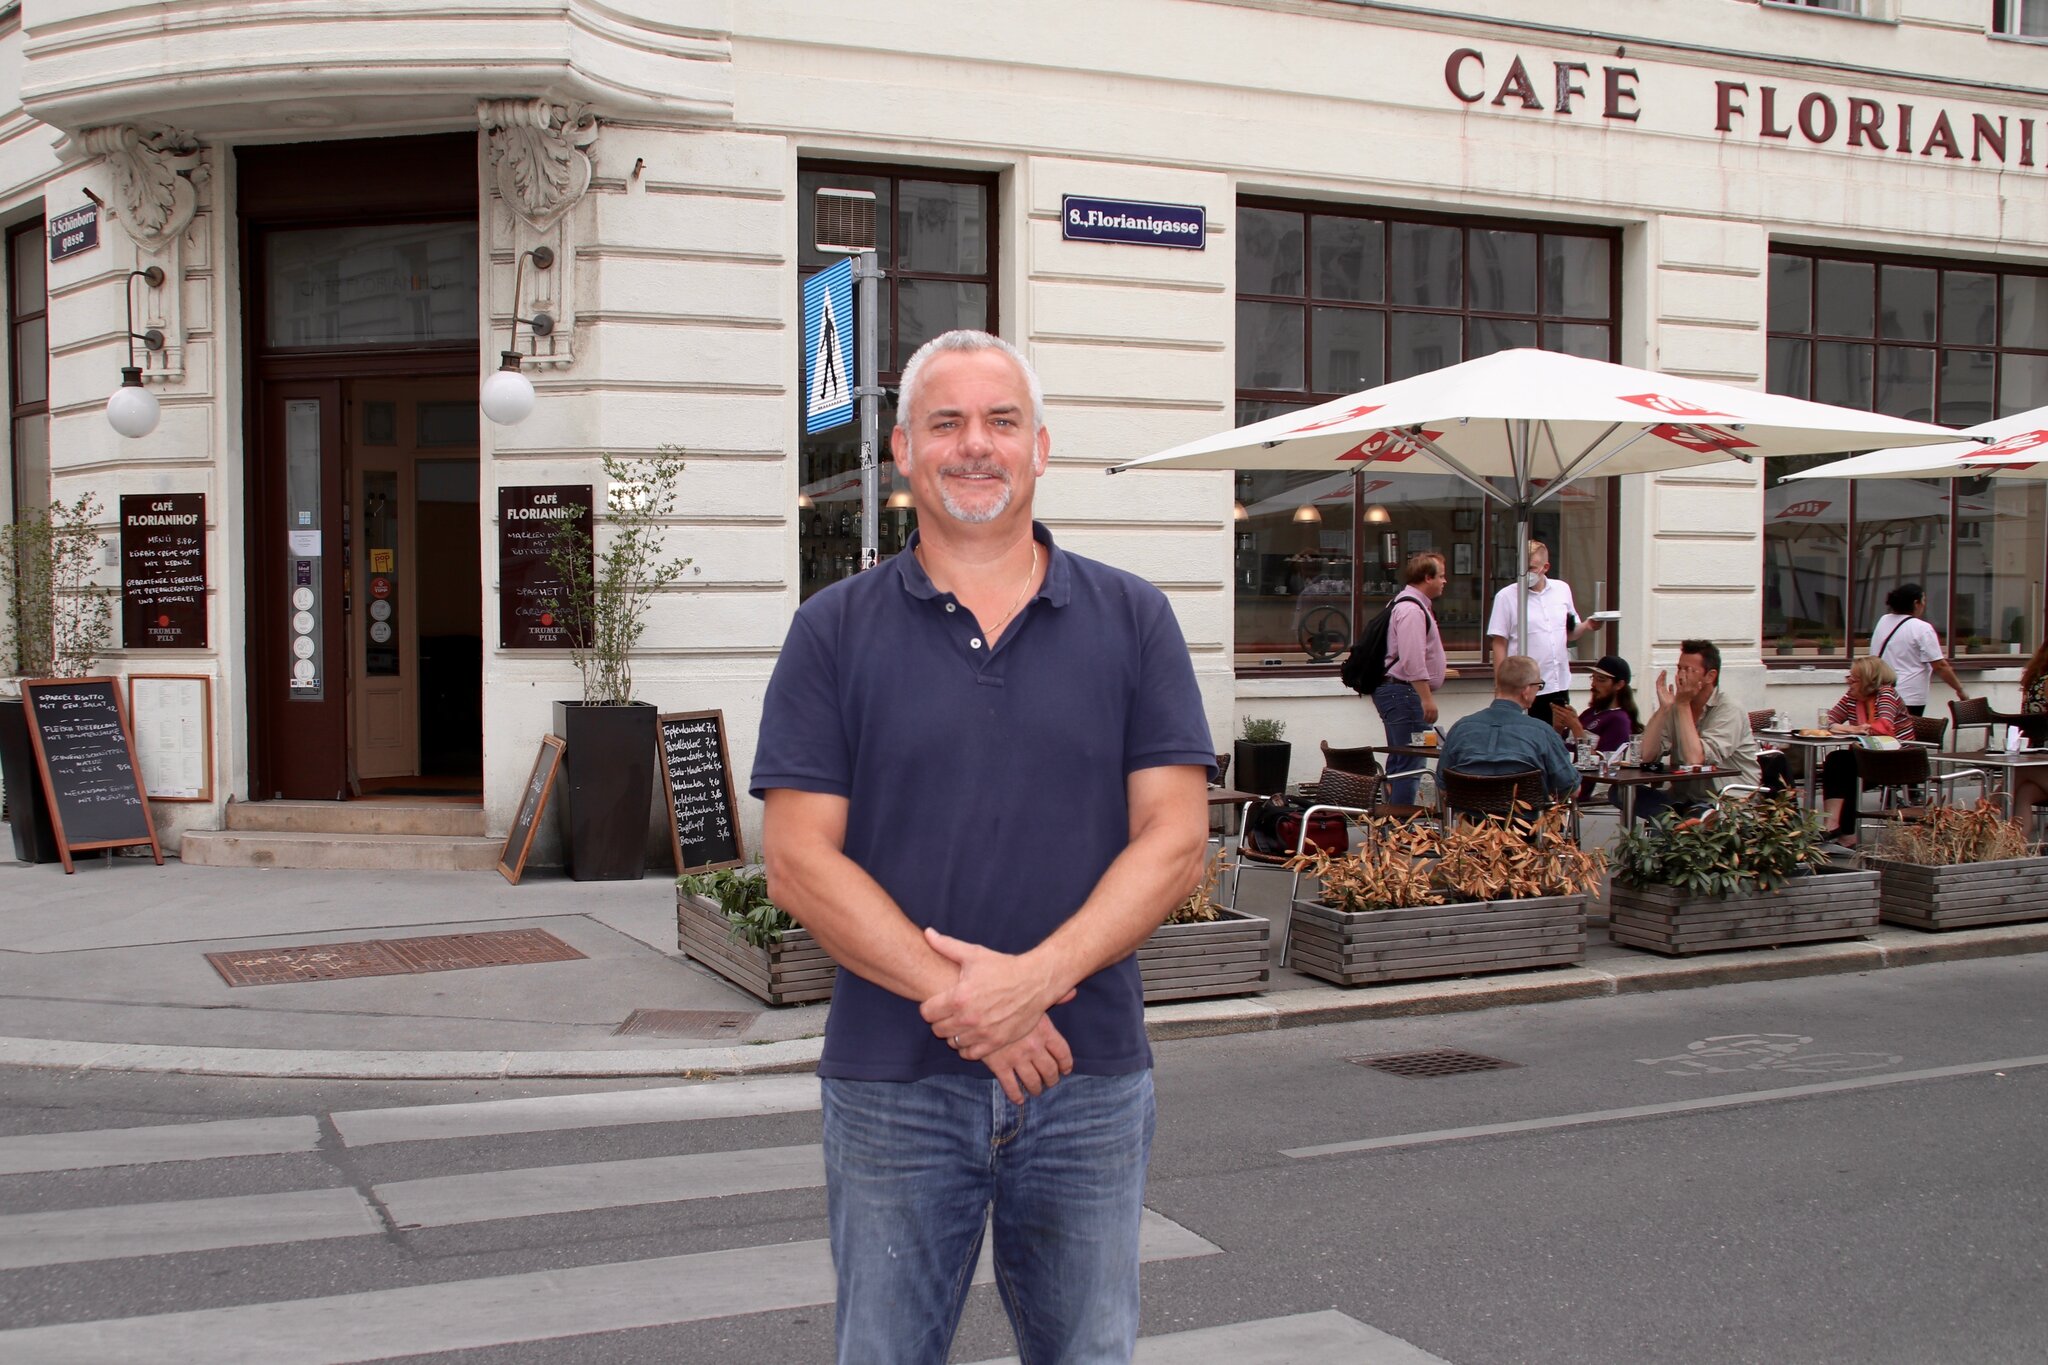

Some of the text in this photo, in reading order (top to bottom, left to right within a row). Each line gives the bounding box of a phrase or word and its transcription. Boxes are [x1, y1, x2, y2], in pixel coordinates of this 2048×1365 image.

[1714, 80, 2048, 168] FLORIANI
[62, 231, 84, 252] gasse
[533, 492, 558, 505] CAFÉ
[151, 500, 173, 512] CAFÉ
[128, 514, 198, 526] FLORIANIHOF
[147, 627, 183, 635] TRUMER
